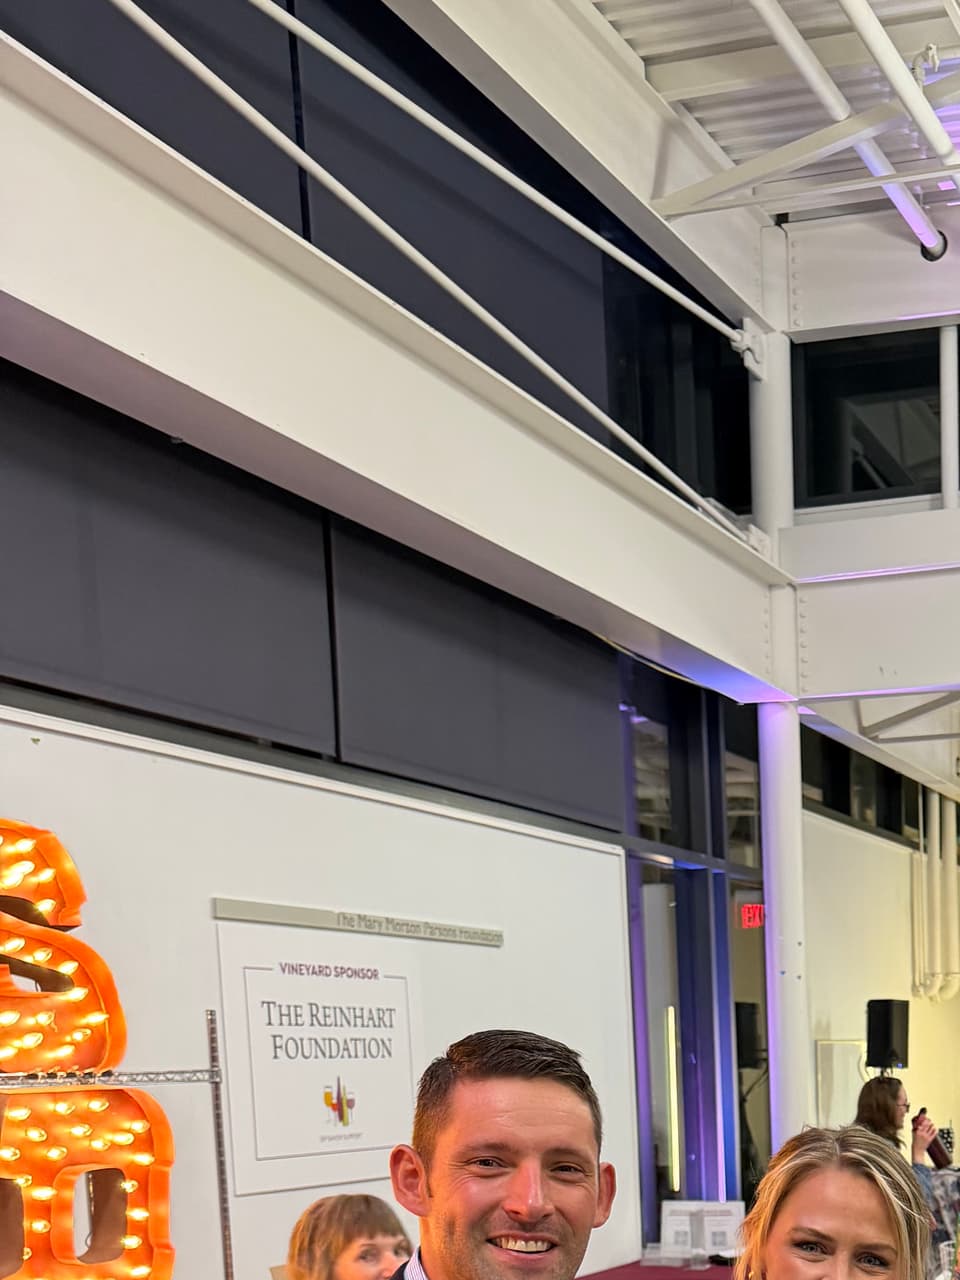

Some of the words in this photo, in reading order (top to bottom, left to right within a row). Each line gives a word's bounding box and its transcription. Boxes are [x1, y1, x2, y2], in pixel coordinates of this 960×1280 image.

[741, 903, 764, 928] EXI
[279, 962, 332, 977] VINEYARD
[334, 966, 380, 980] SPONSOR
[261, 1000, 305, 1027] THE
[307, 1002, 397, 1029] REINHART
[271, 1034, 393, 1060] FOUNDATION
